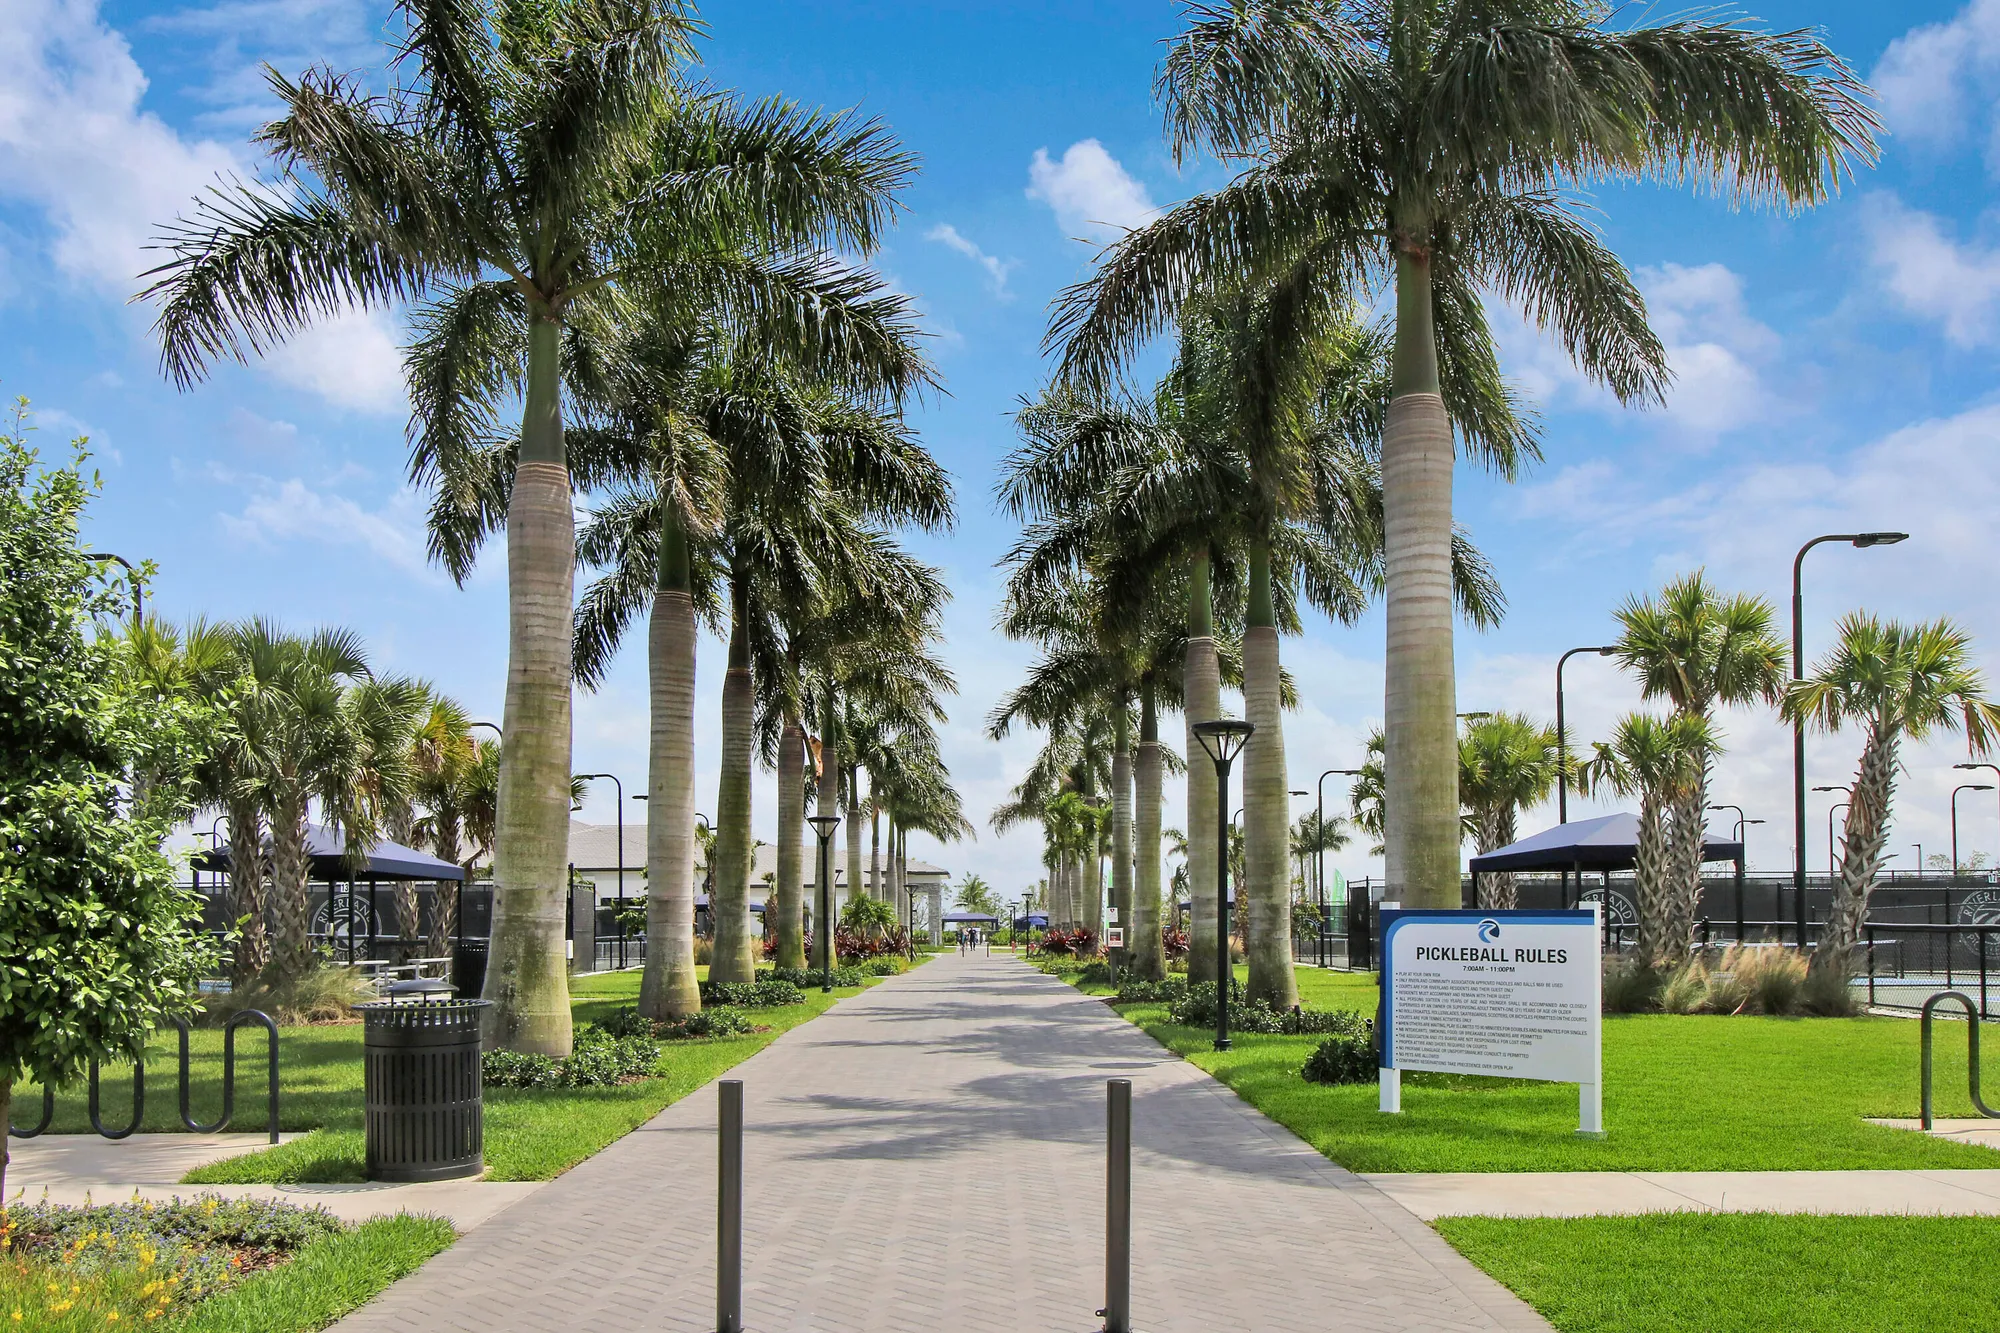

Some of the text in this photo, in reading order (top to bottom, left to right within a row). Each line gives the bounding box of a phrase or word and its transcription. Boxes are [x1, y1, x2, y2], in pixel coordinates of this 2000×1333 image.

[341, 884, 349, 892] 13
[1963, 891, 2000, 917] RIVERL
[1416, 947, 1567, 964] PICKLEBALL RULES
